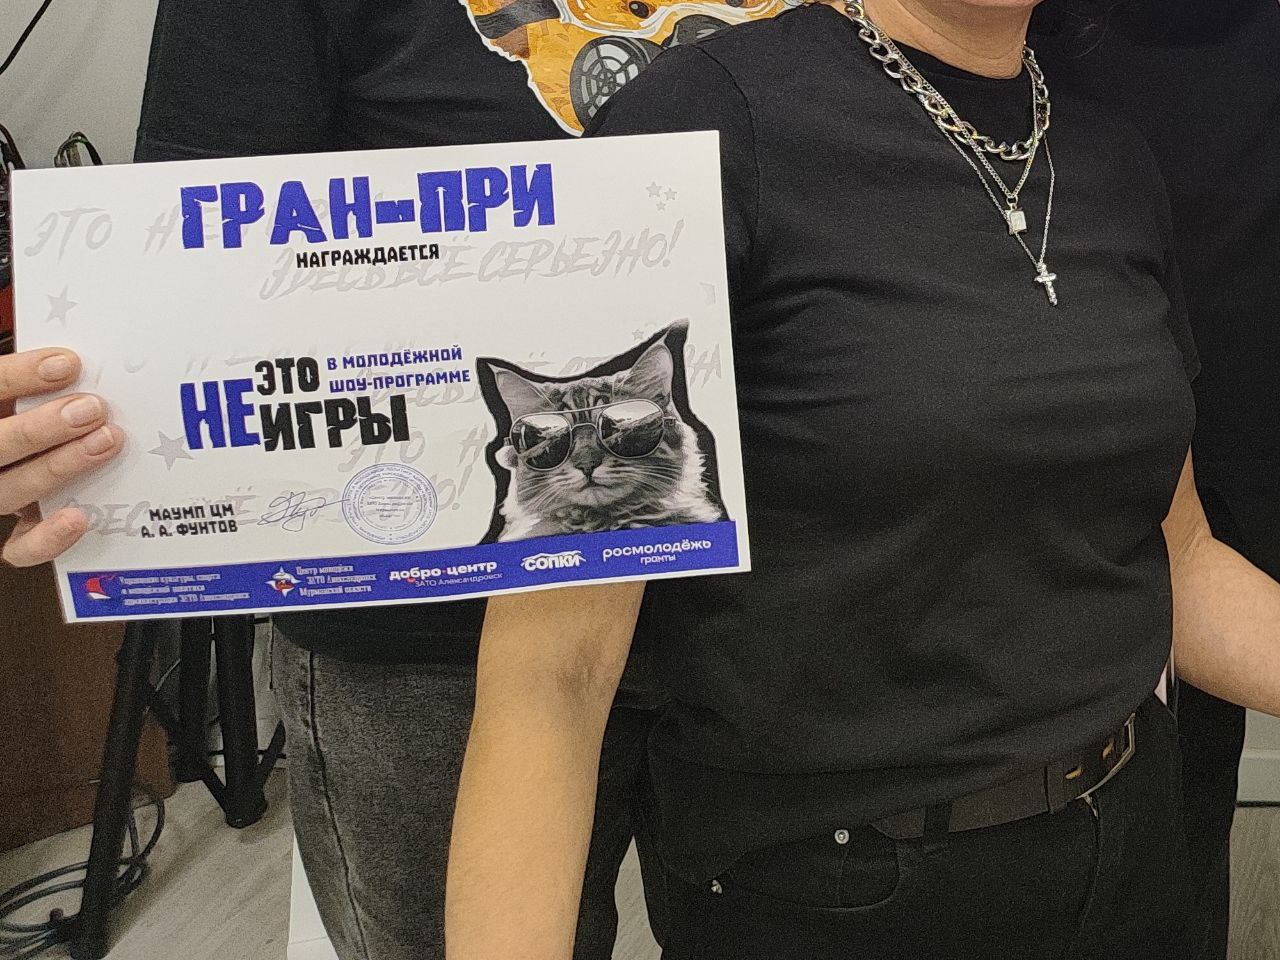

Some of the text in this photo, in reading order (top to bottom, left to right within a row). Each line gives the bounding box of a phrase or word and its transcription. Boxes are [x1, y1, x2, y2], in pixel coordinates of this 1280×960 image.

[180, 164, 556, 249] ГРАН-ПРИ
[297, 243, 440, 268] НАГРАЖДАЕТСЯ
[343, 344, 463, 369] МОЛОДЁЖНОЙ
[254, 356, 321, 396] ЭТО
[329, 370, 471, 393] ШОУ-ПРОГРАММЕ
[180, 378, 411, 451] НЕ ИГРЫ
[149, 506, 206, 522] МАУМП
[211, 503, 234, 520] ЦМ
[177, 519, 238, 537] ФУНТОВ
[602, 538, 712, 562] росмолодёжь
